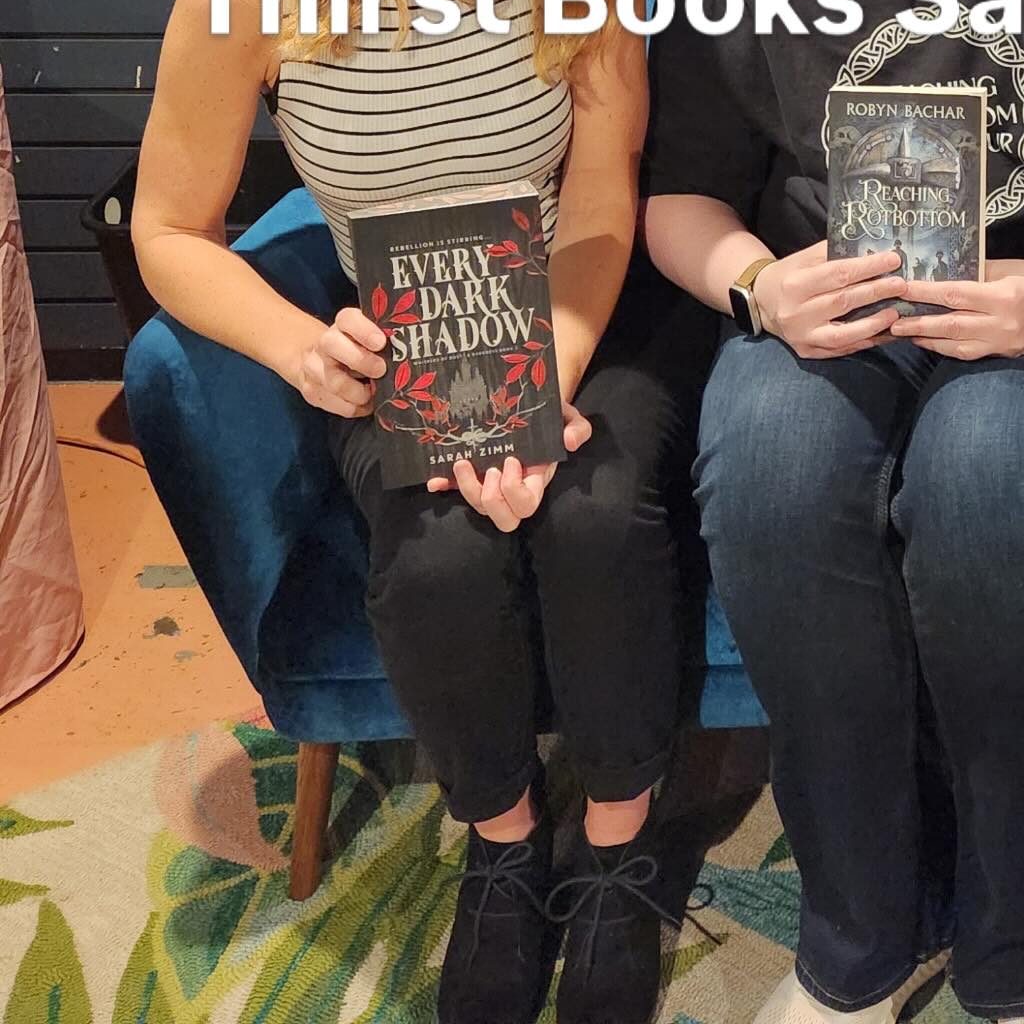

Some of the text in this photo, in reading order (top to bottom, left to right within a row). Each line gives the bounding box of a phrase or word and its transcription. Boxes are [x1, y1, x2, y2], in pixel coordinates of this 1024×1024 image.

[846, 102, 966, 120] ROBYN BACHAR
[858, 179, 951, 210] REACHING
[841, 200, 966, 240] ROTBOTTOM
[389, 240, 435, 253] REBELLION
[389, 243, 494, 290] EVERY
[419, 275, 524, 322] DARK
[390, 307, 535, 362] SHADOW
[429, 443, 515, 465] SARAH ZIMM
